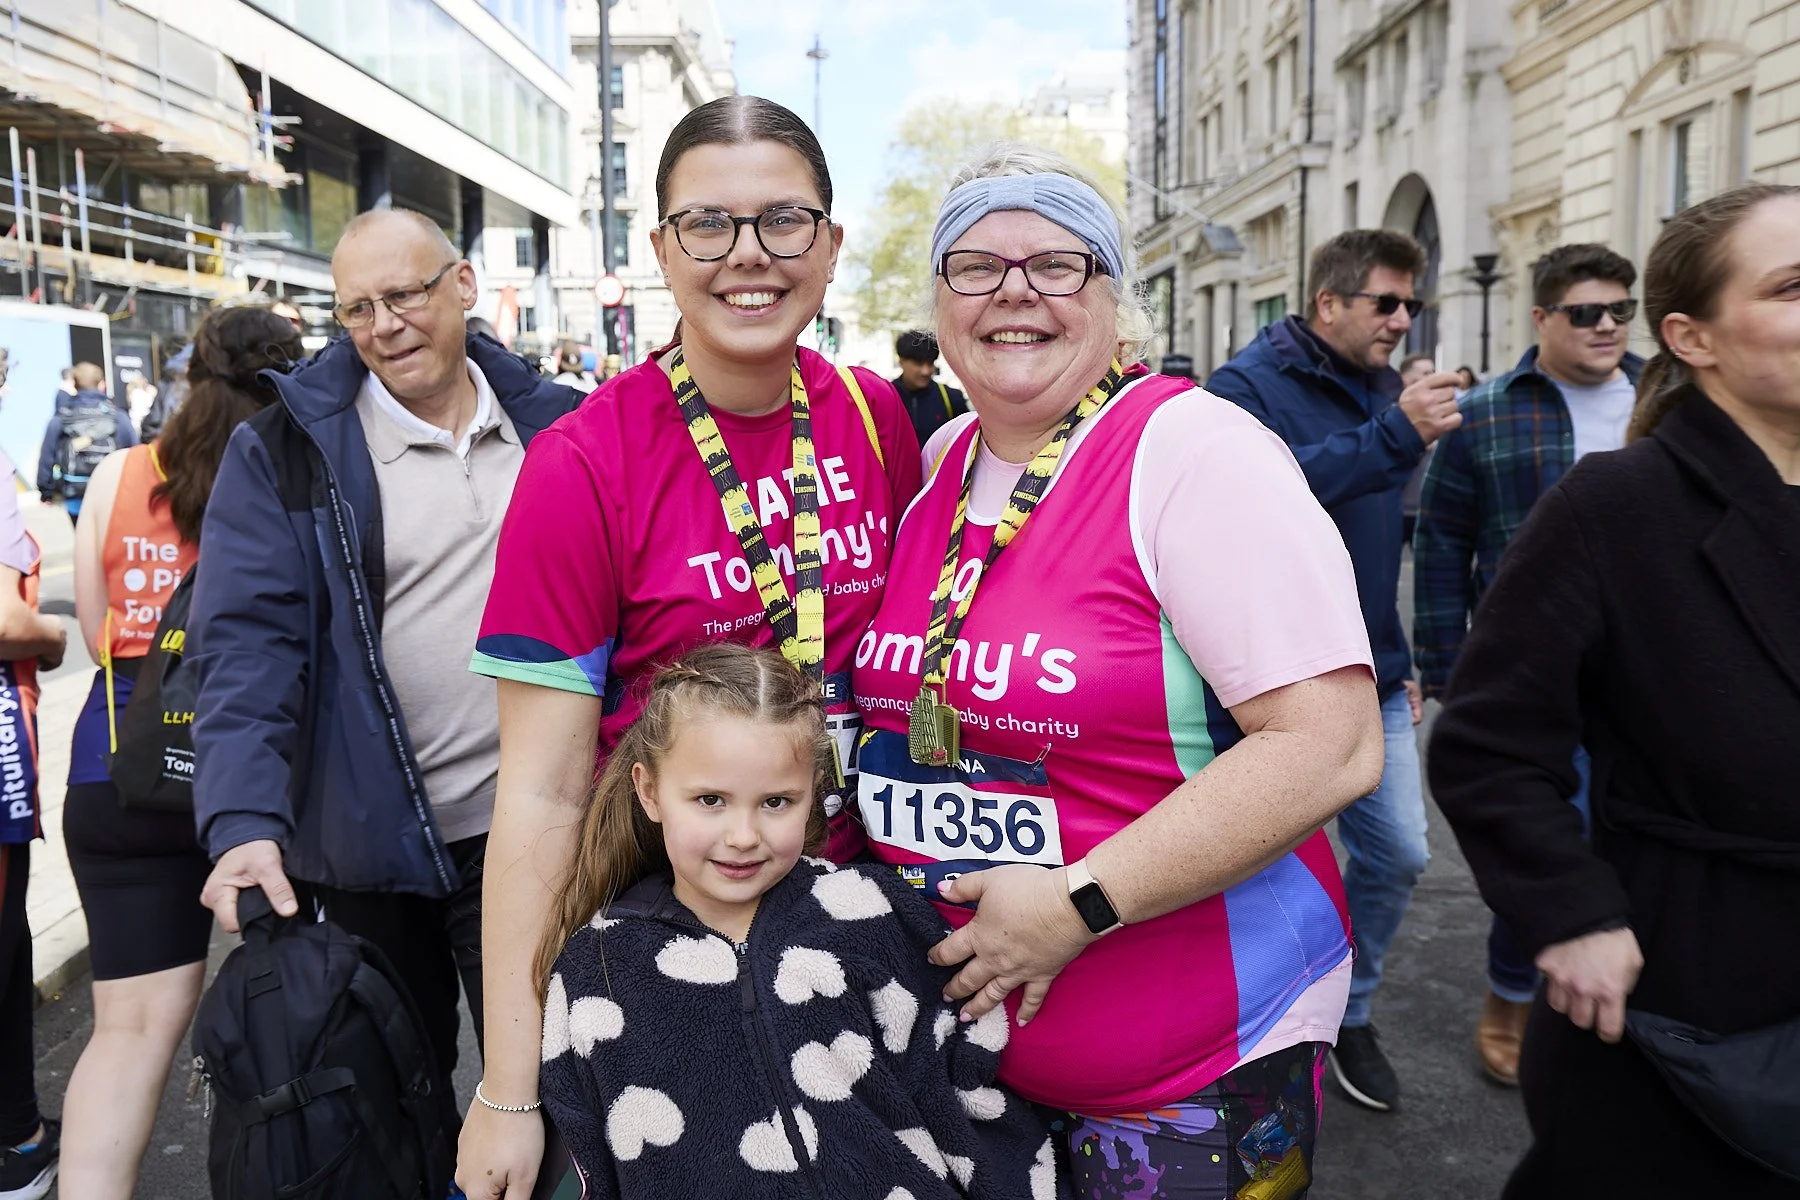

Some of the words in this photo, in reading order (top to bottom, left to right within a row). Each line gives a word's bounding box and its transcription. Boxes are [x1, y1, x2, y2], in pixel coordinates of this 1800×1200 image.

[709, 459, 731, 476] FINISHER
[1013, 491, 1038, 503] FINISHER
[122, 536, 179, 563] The
[742, 532, 763, 550] FINISHER
[796, 560, 820, 571] FINISHER
[703, 620, 732, 636] The
[833, 578, 869, 595] baby
[769, 606, 792, 624] FINISHER
[855, 620, 1078, 702] ommy's
[955, 706, 989, 731] aby
[995, 713, 1080, 739] charity
[873, 784, 1046, 856] 11356
